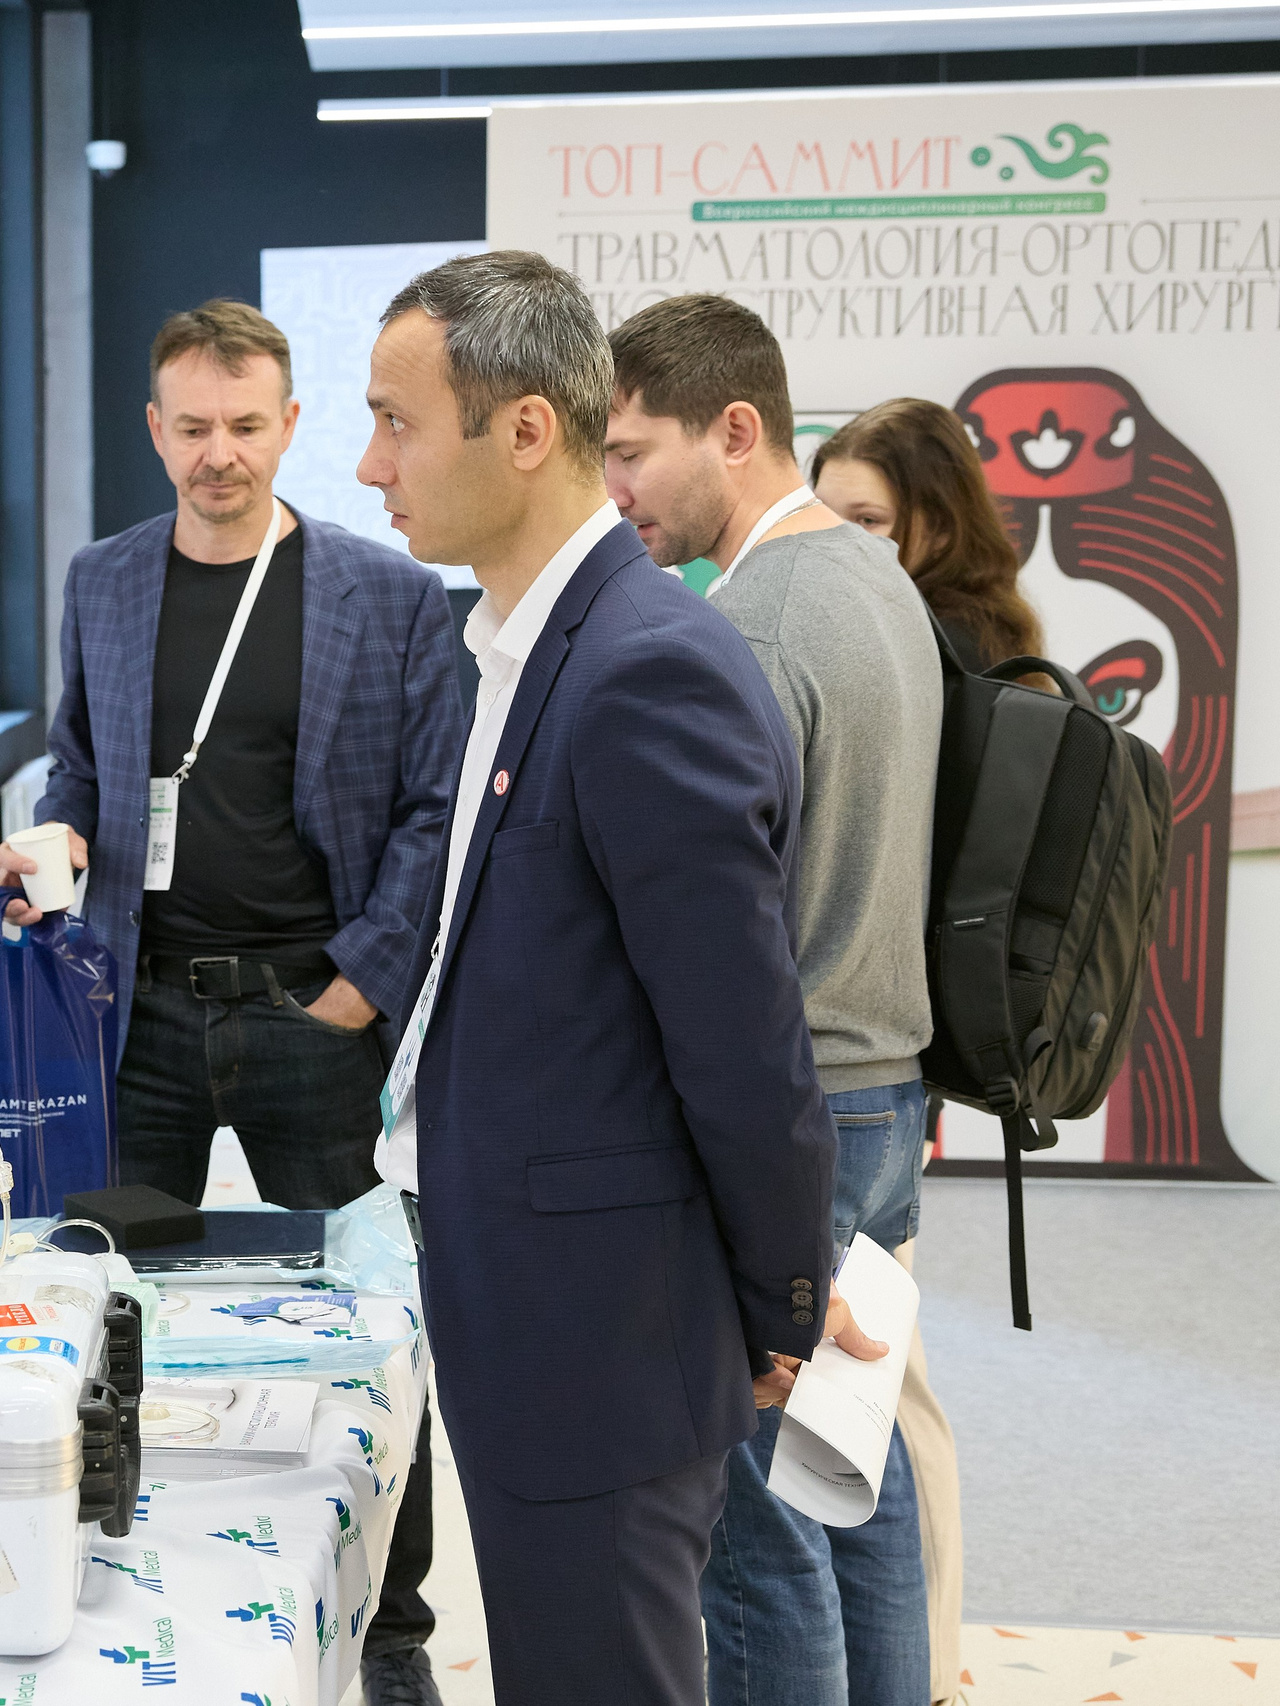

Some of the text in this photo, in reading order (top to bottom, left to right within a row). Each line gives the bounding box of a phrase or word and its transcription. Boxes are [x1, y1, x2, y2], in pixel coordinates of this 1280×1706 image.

[548, 136, 961, 198] ТОП-САММИТ
[558, 218, 1280, 284] ТРАВМАТОЛОГИЯ-ОРТОПЕД
[1091, 279, 1280, 334] ХИРУРГ
[131, 1573, 164, 1594] VIT
[140, 1550, 161, 1577] Medical
[268, 1585, 297, 1648] VIT Medical
[142, 1616, 176, 1687] VIT Medical
